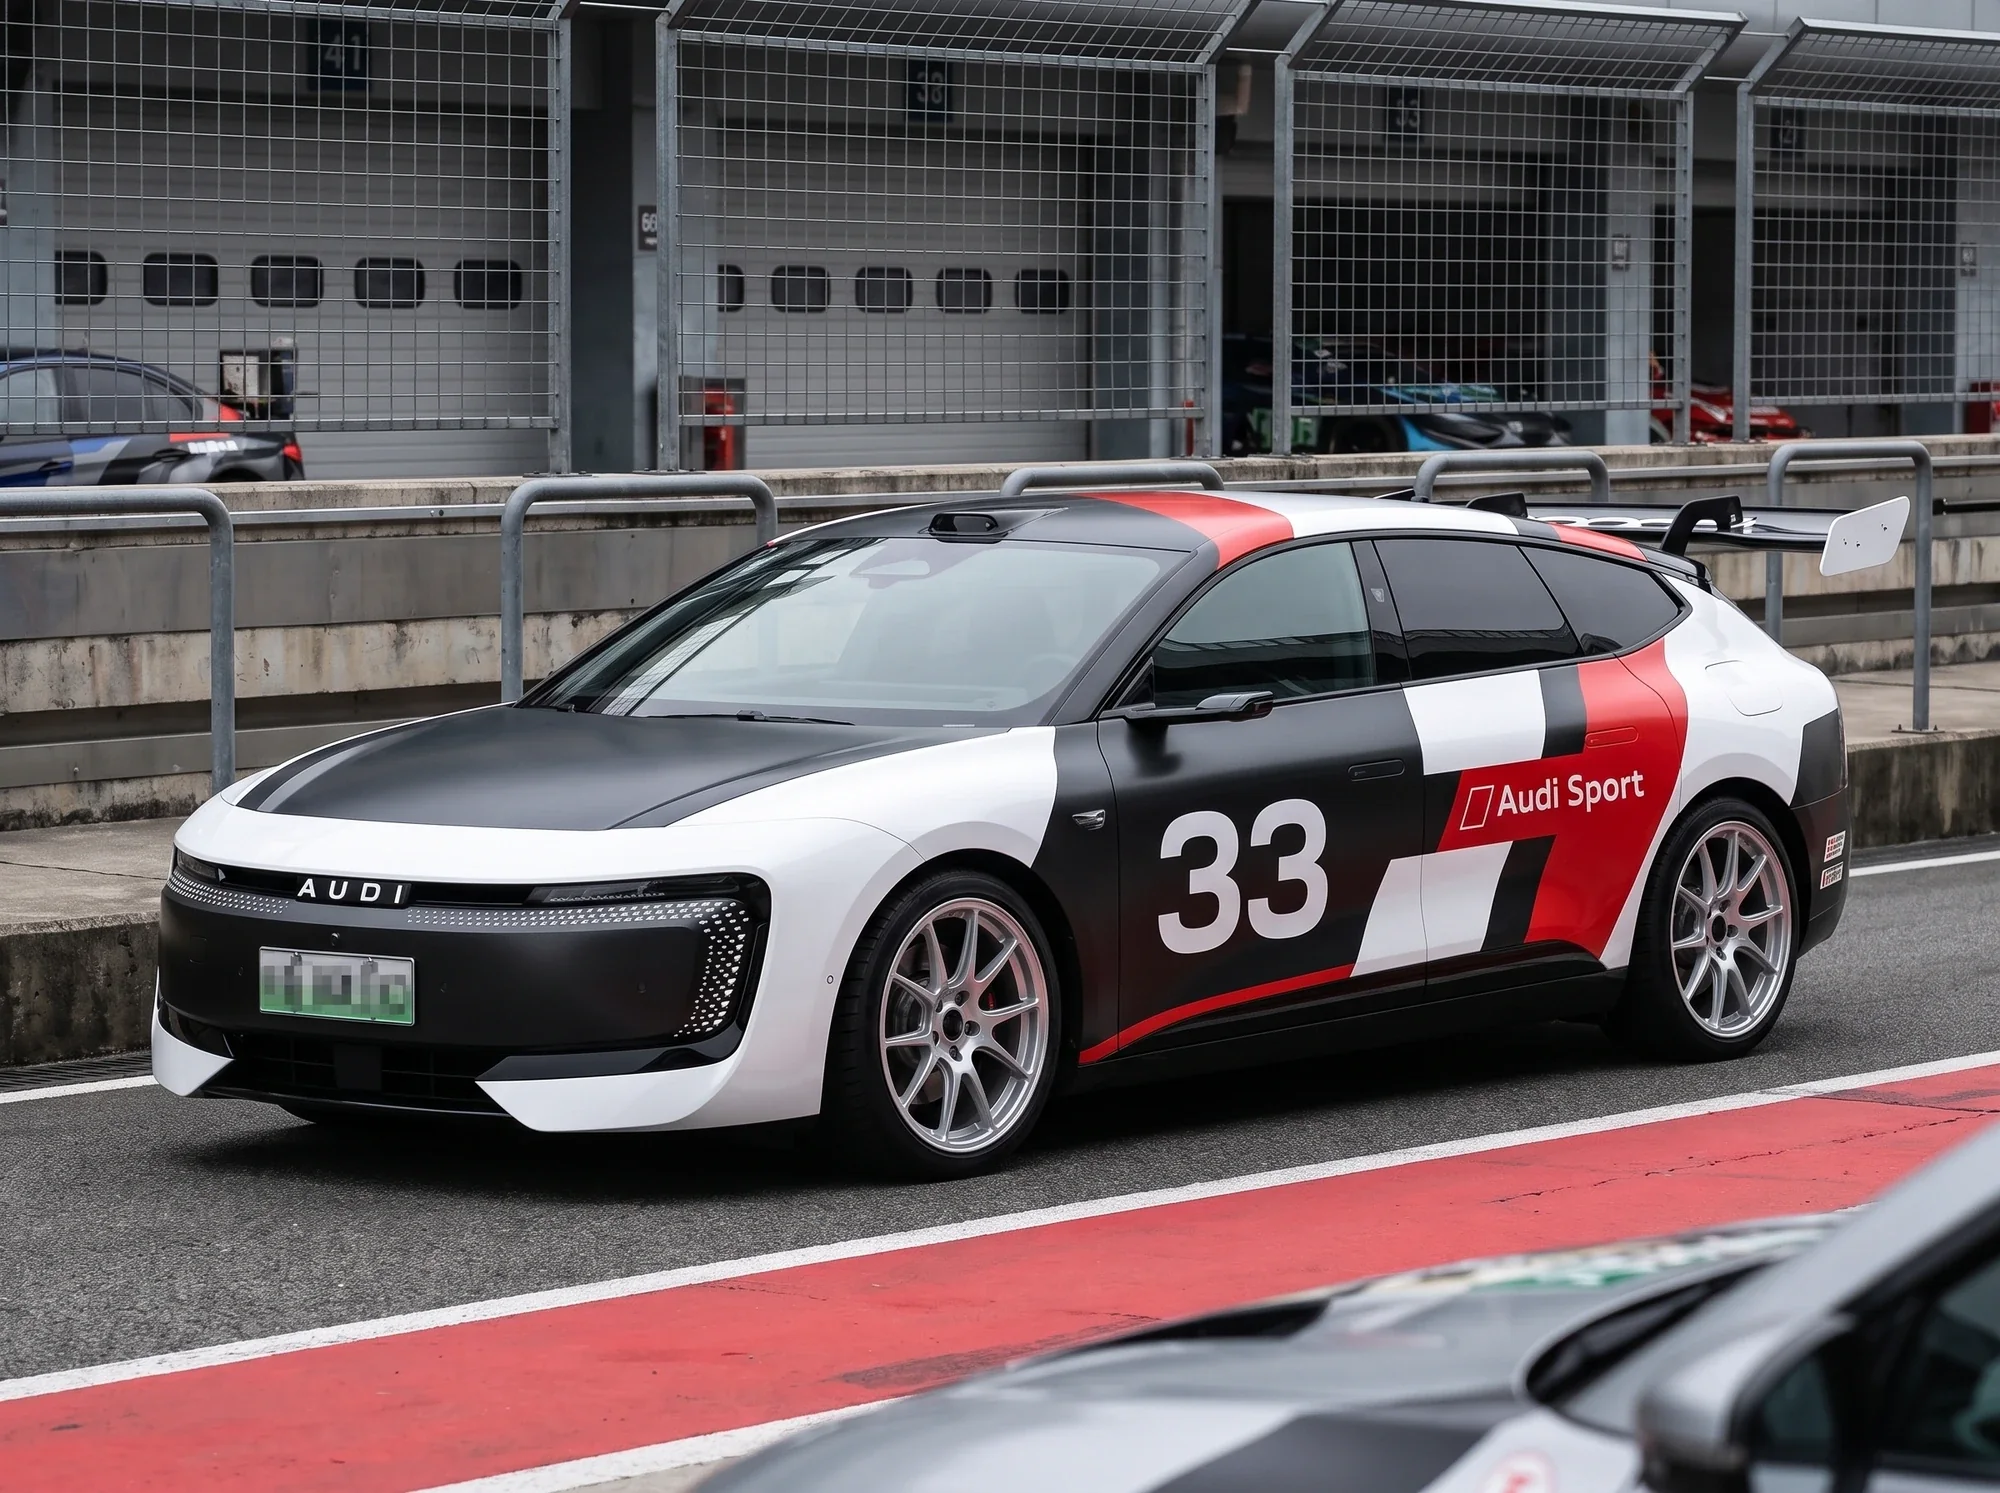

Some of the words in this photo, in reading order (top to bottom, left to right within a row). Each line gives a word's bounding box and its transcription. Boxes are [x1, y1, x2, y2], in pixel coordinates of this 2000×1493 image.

[324, 33, 361, 70] 41
[916, 71, 943, 104] 38
[1497, 777, 1559, 817] Audi
[1567, 770, 1645, 813] Sport
[297, 878, 403, 904] AUDI
[1158, 798, 1328, 954] 33
